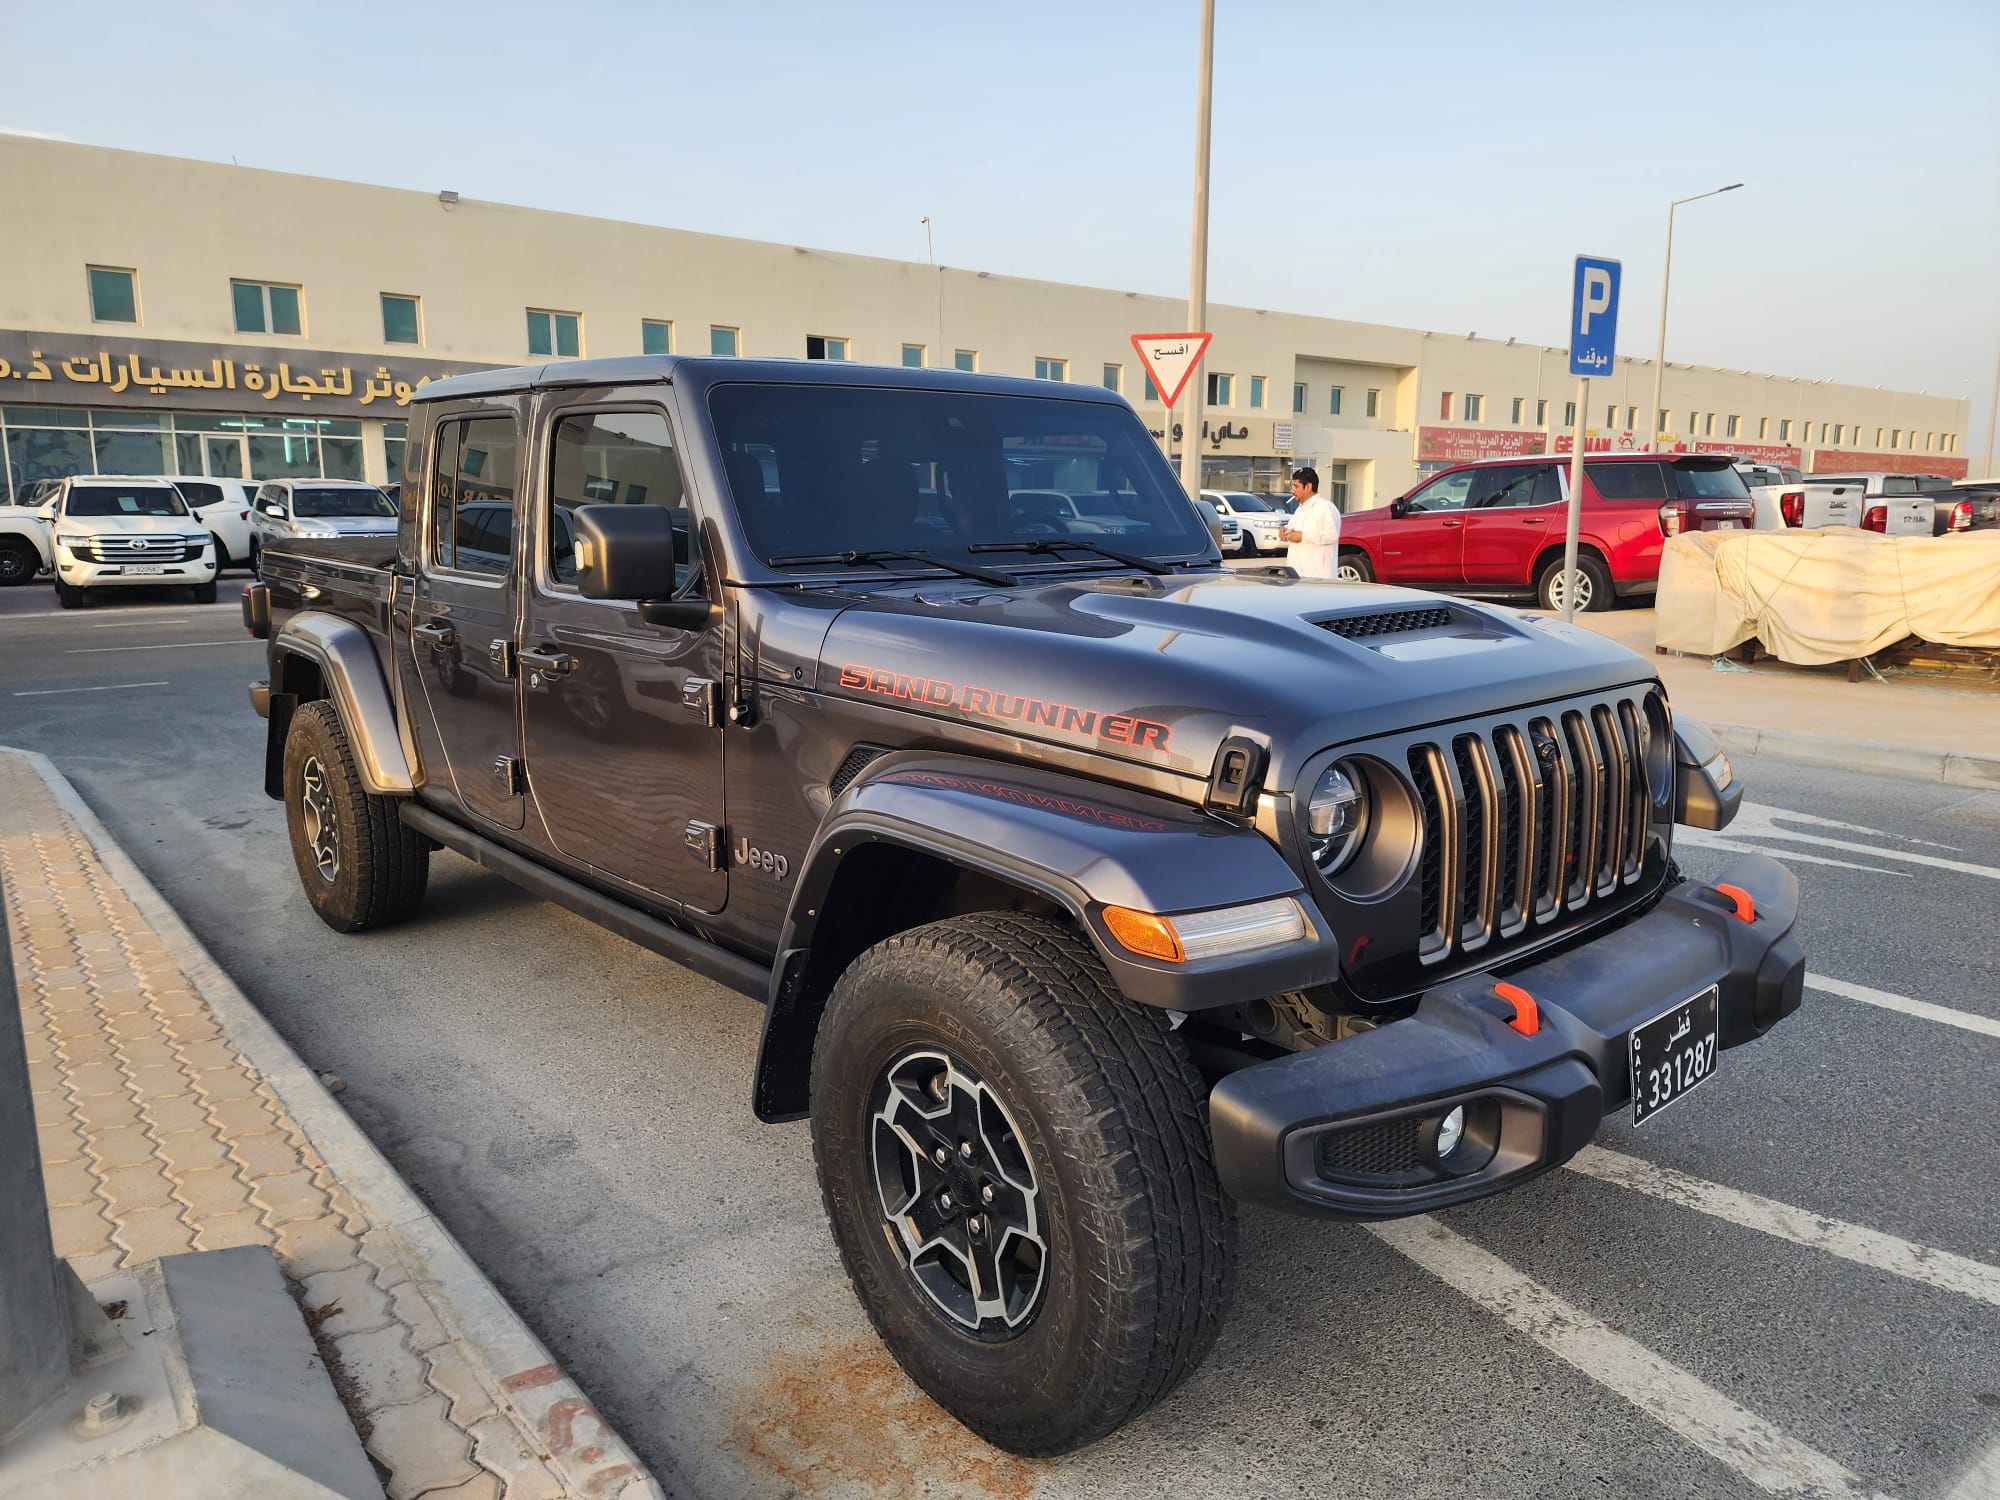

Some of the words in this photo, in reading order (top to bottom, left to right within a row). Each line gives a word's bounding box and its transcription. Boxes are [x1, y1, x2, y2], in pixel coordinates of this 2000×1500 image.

[1580, 266, 1612, 335] P
[61, 351, 236, 394] السيارات
[1153, 344, 1189, 360] افسح
[1577, 347, 1608, 368] موقف
[244, 362, 353, 401] لتجارة
[839, 662, 956, 708] SAND
[958, 685, 1173, 753] RUNNER
[734, 837, 789, 881] Jeep
[1664, 1008, 1691, 1052] قطر
[1634, 1038, 1642, 1117] QATAR
[1648, 1032, 1716, 1109] 331287
